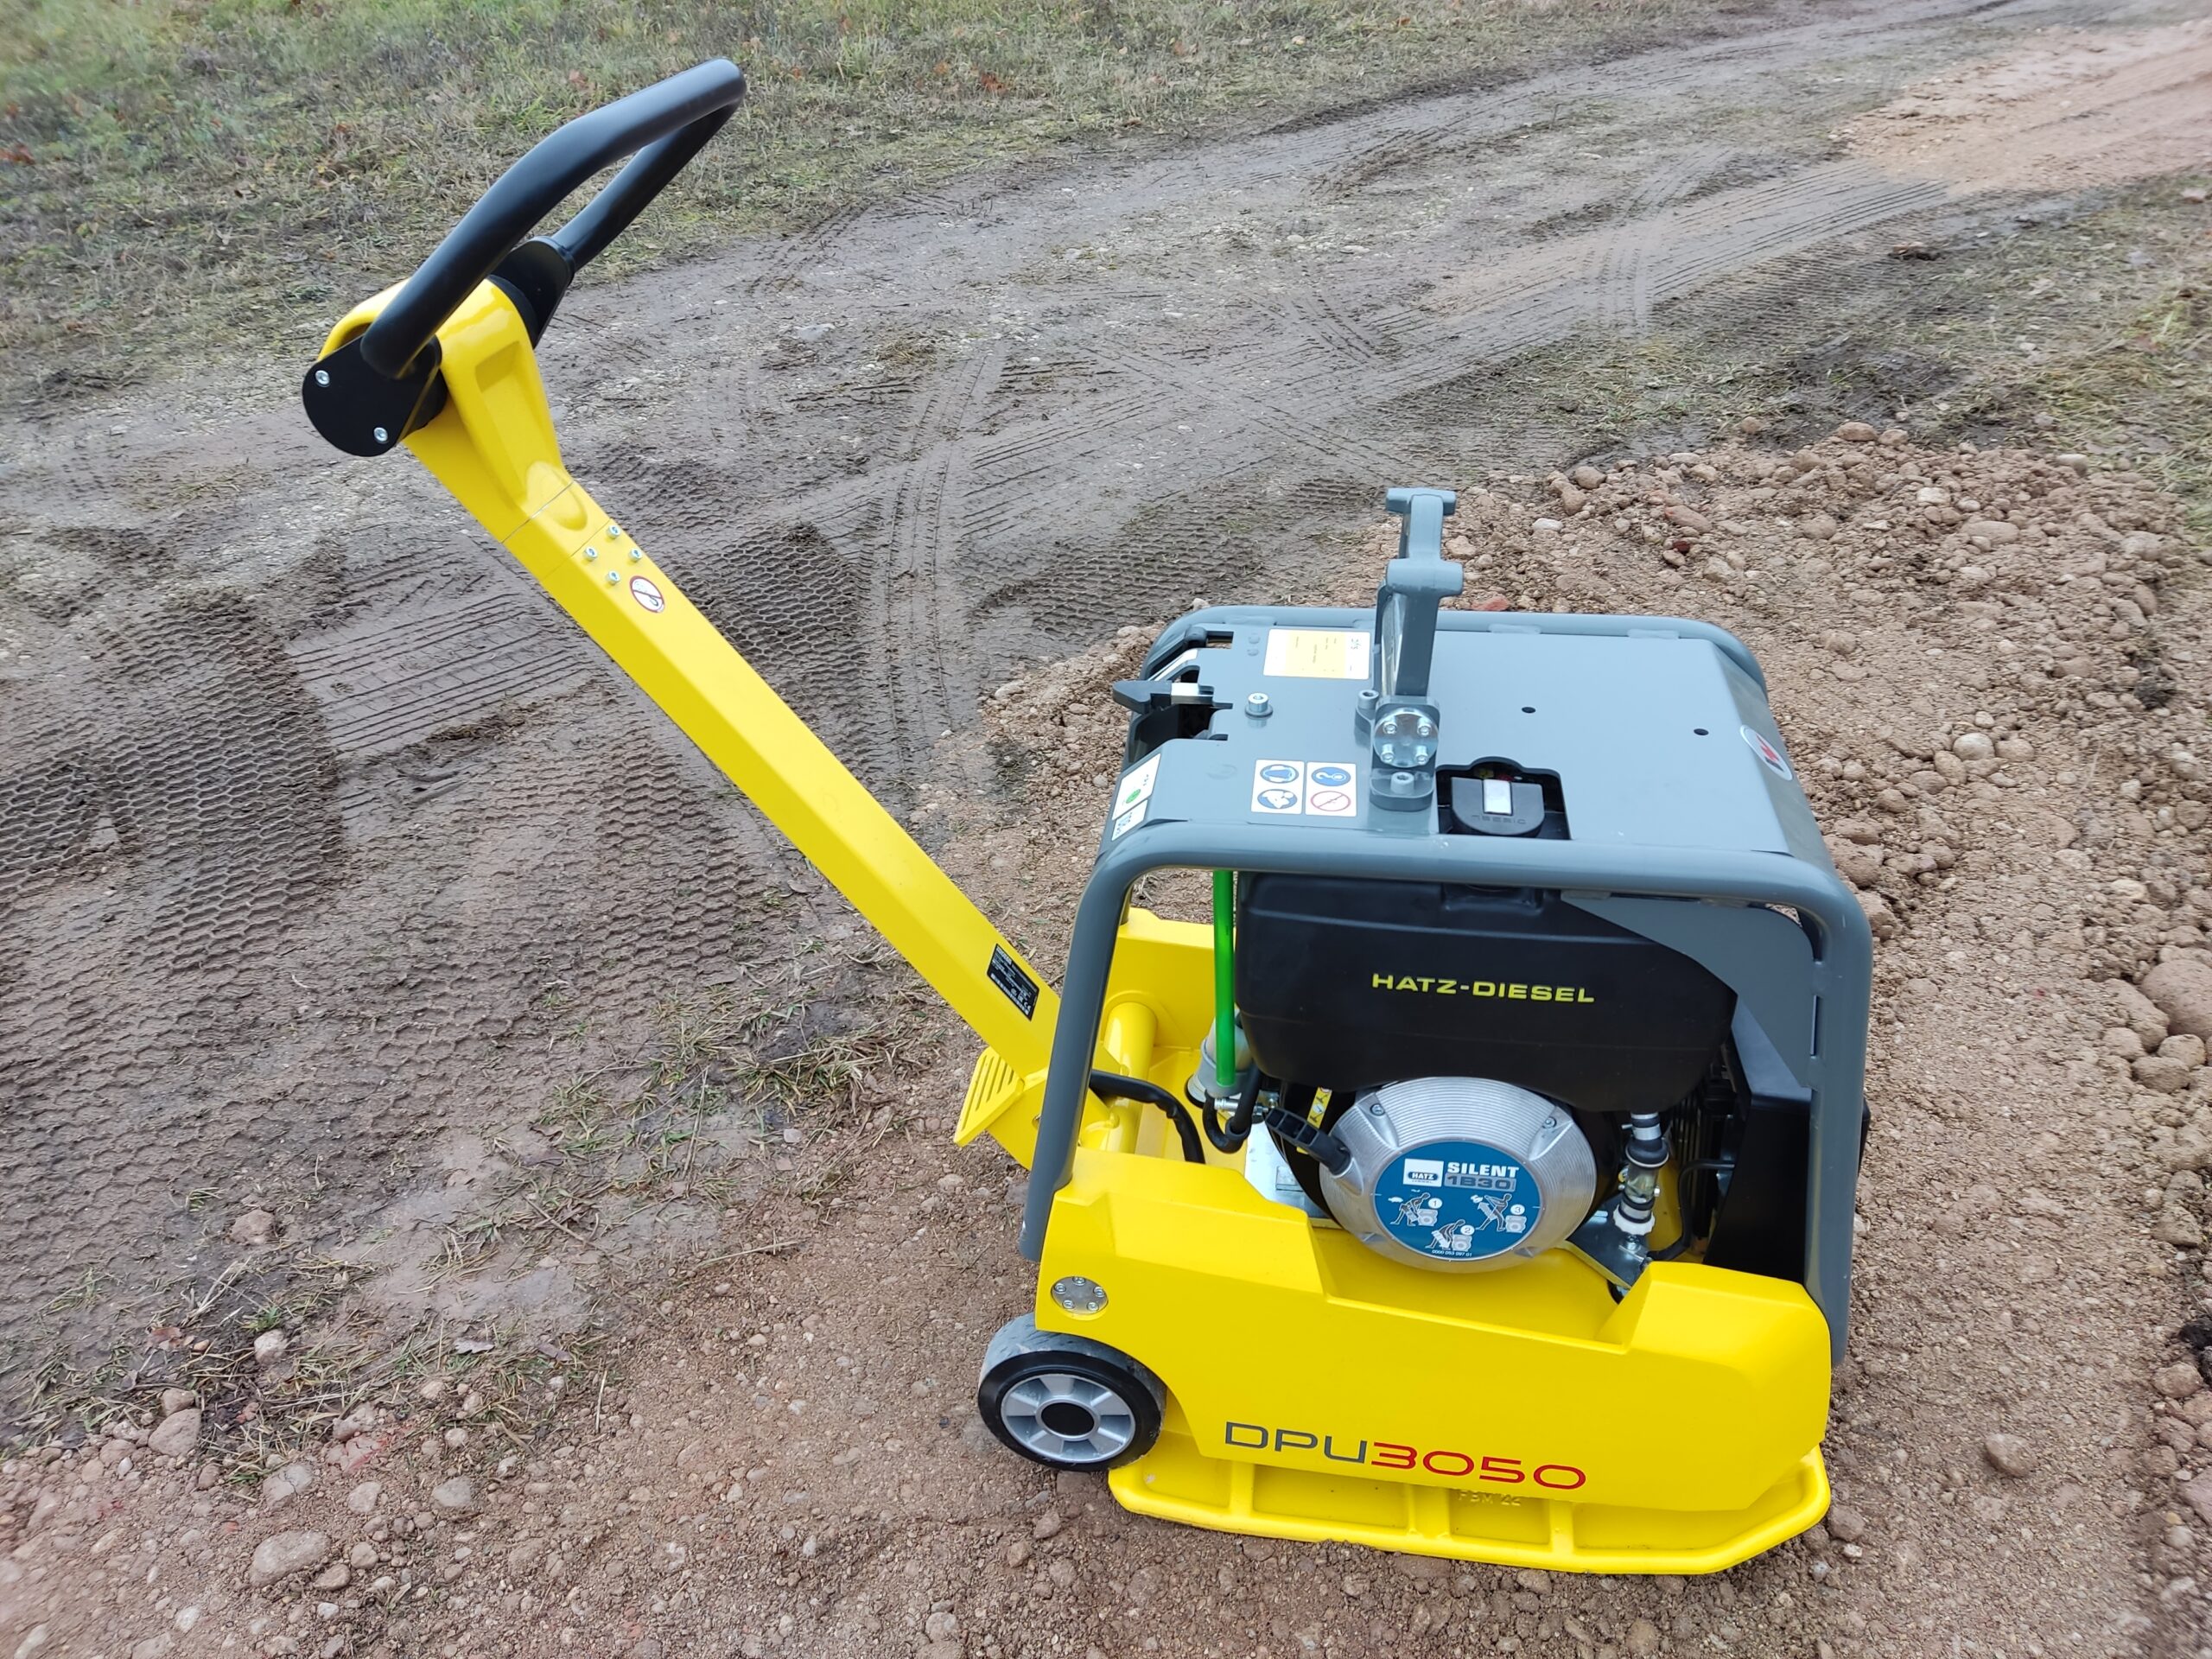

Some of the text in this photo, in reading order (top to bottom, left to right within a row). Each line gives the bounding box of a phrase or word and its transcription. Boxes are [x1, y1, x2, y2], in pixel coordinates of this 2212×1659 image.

[1372, 973, 1595, 1003] HATZ-DIESEL
[1411, 1172, 1435, 1180] HATZ
[1447, 1161, 1519, 1178] SILENT
[1446, 1175, 1511, 1191] 1B30
[1225, 1421, 1586, 1490] DPU3050
